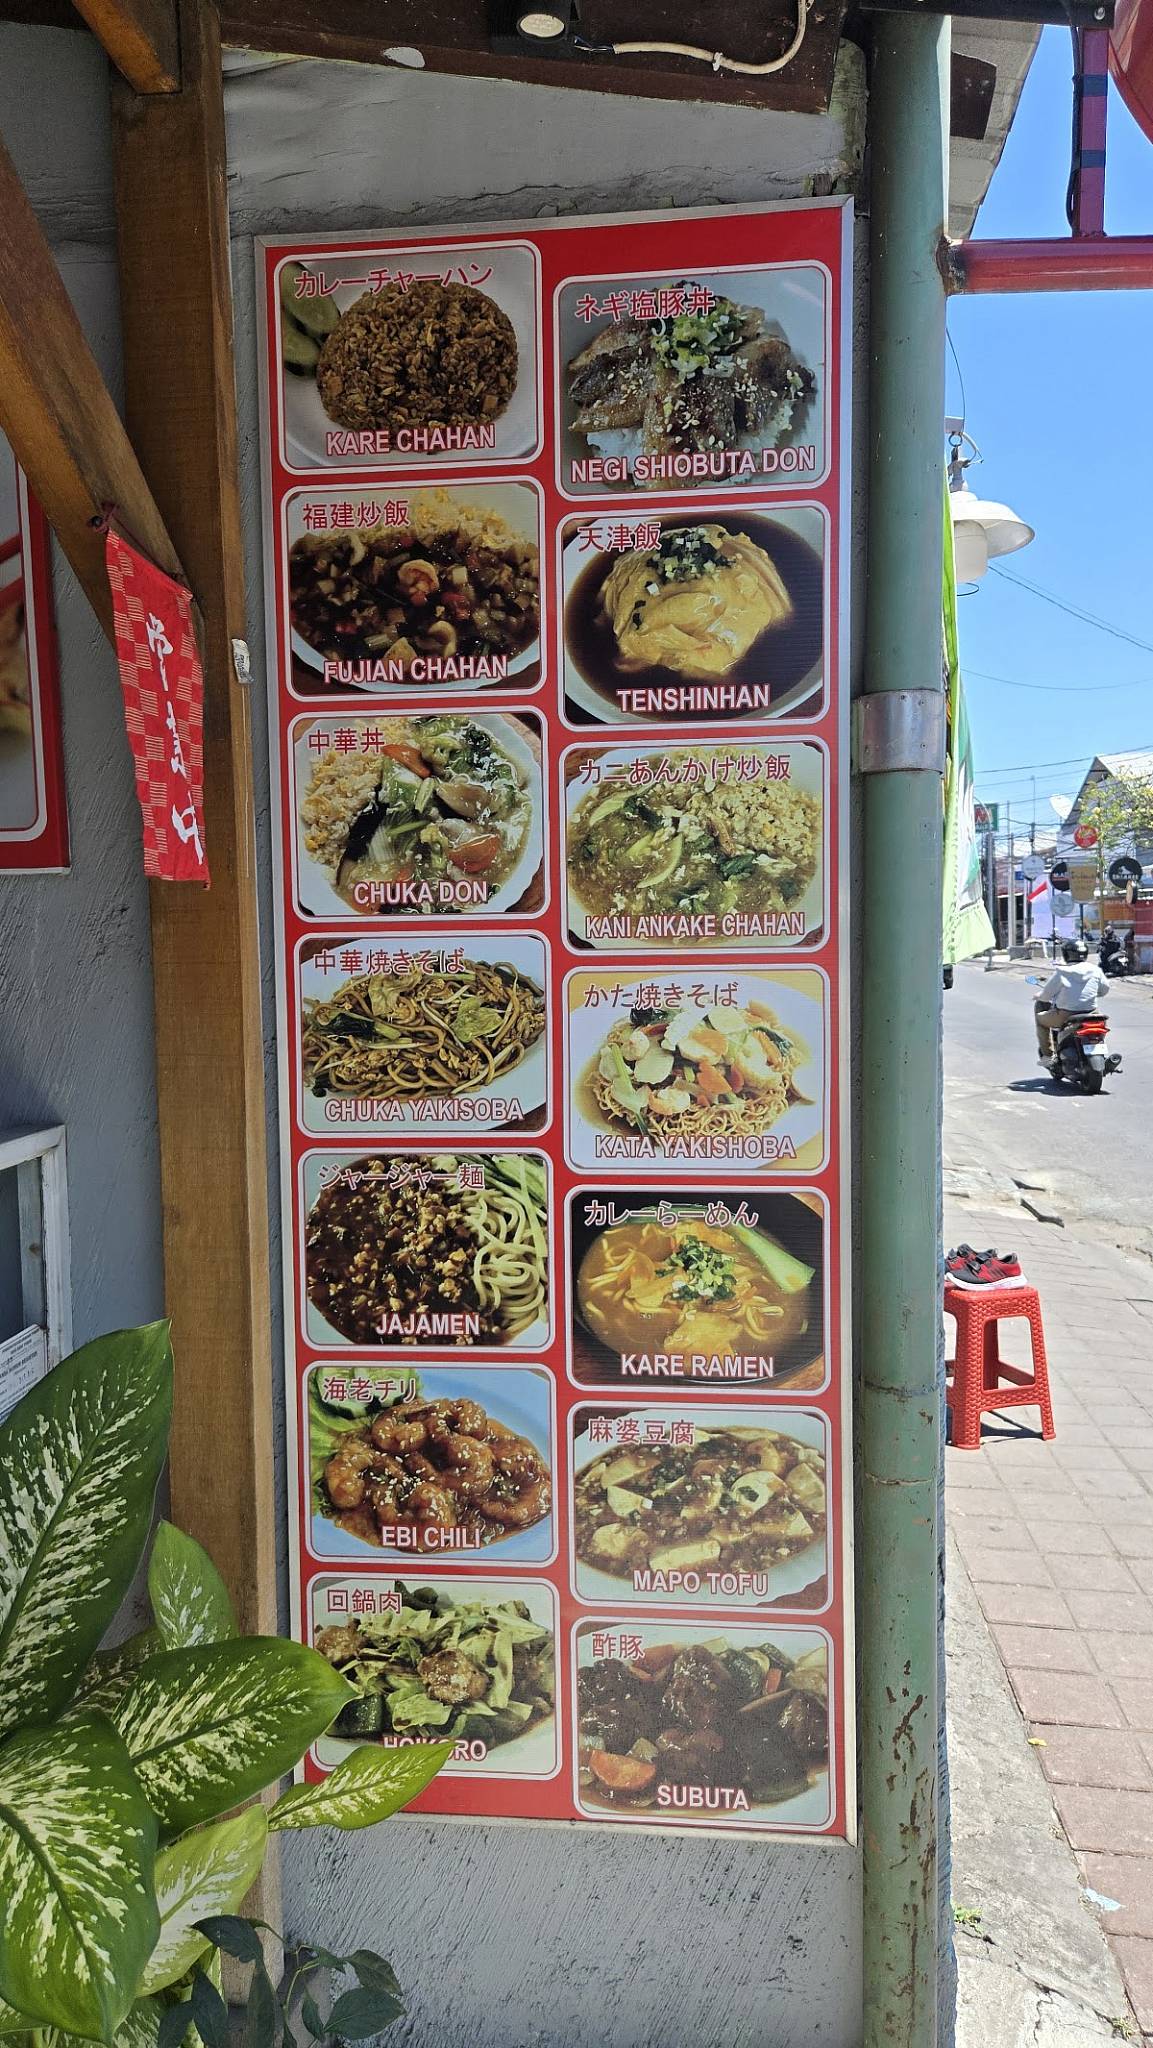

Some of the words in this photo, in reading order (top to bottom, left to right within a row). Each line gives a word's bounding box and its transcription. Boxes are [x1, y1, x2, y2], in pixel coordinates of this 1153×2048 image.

[294, 263, 494, 298] カレーチャーハン
[575, 286, 715, 323] ネギ塩豚丼
[326, 431, 390, 456] KARE
[396, 424, 496, 452] CHAHAN
[571, 457, 627, 483] NEGI
[634, 451, 755, 480] SHIOBUTA
[761, 447, 816, 474] DON
[302, 500, 410, 530] 福建炒飯
[578, 523, 661, 551] 天津飯
[324, 660, 407, 683] FUJIAN
[412, 655, 508, 681] CHAHAN
[617, 684, 770, 713] TENSHINHAN
[308, 728, 385, 754] 中華丼
[578, 753, 792, 786] カニあんかけ炒飯
[354, 883, 433, 906] CHUKA
[438, 881, 489, 904] DON
[585, 915, 635, 939] KANI
[636, 914, 717, 938] ANKAKE
[721, 912, 806, 937] CHAHAN
[313, 947, 466, 976] 中華焼きそば
[583, 982, 739, 1010] かた焼きそば
[324, 1098, 403, 1122] CHUKA
[404, 1098, 524, 1122] YAKISOBA
[594, 1137, 657, 1160] KATA
[661, 1135, 796, 1159] YAKISHOBA
[318, 1163, 485, 1191] ジャージャー麺
[583, 1200, 759, 1227] カレーらーめん
[375, 1313, 480, 1337] JAJAMEN
[620, 1354, 685, 1378] KARE
[689, 1355, 774, 1379] RAMEN
[322, 1377, 416, 1404] 海老チリ
[588, 1416, 696, 1446] 麻婆豆腐
[381, 1526, 418, 1548] EBI
[422, 1527, 481, 1549] CHILI
[632, 1570, 701, 1592] MAPO
[705, 1572, 769, 1596] TOFU
[327, 1588, 402, 1615] 回鍋肉
[591, 1633, 645, 1660] 酢豚
[657, 1784, 749, 1810] SUBUTA
